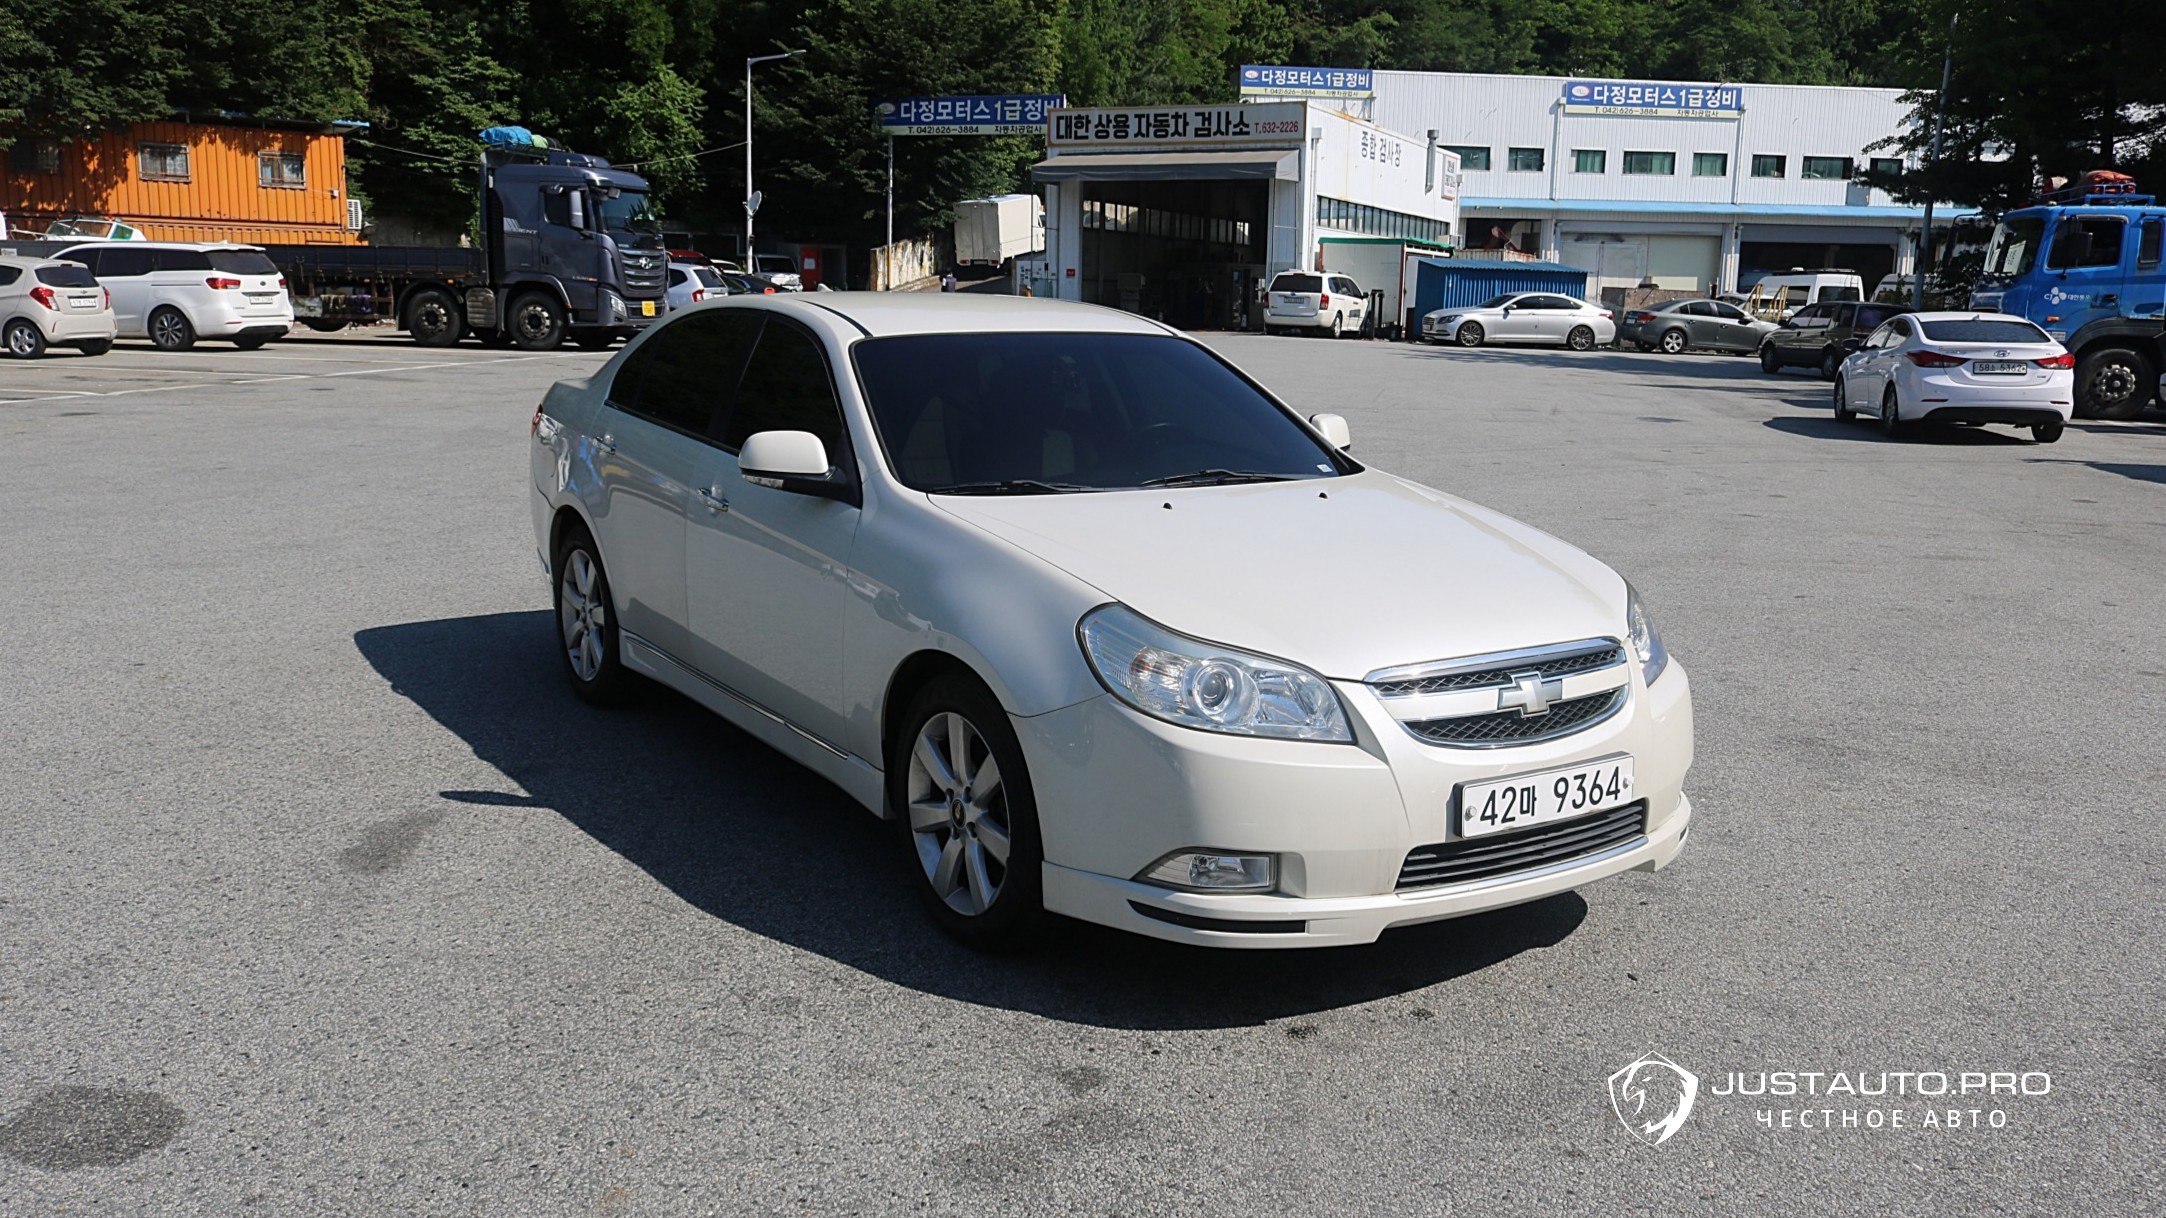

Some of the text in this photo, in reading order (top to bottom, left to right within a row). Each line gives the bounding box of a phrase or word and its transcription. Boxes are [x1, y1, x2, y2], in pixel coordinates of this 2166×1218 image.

[1056, 113, 1091, 140] 대한
[1094, 113, 1130, 140] 상용
[1134, 111, 1189, 138] 자동차
[1194, 110, 1250, 138] 검사소
[1361, 130, 1402, 167] 종합 검사장
[2043, 293, 2053, 301] CJ
[1479, 765, 1621, 826] 42마 9364
